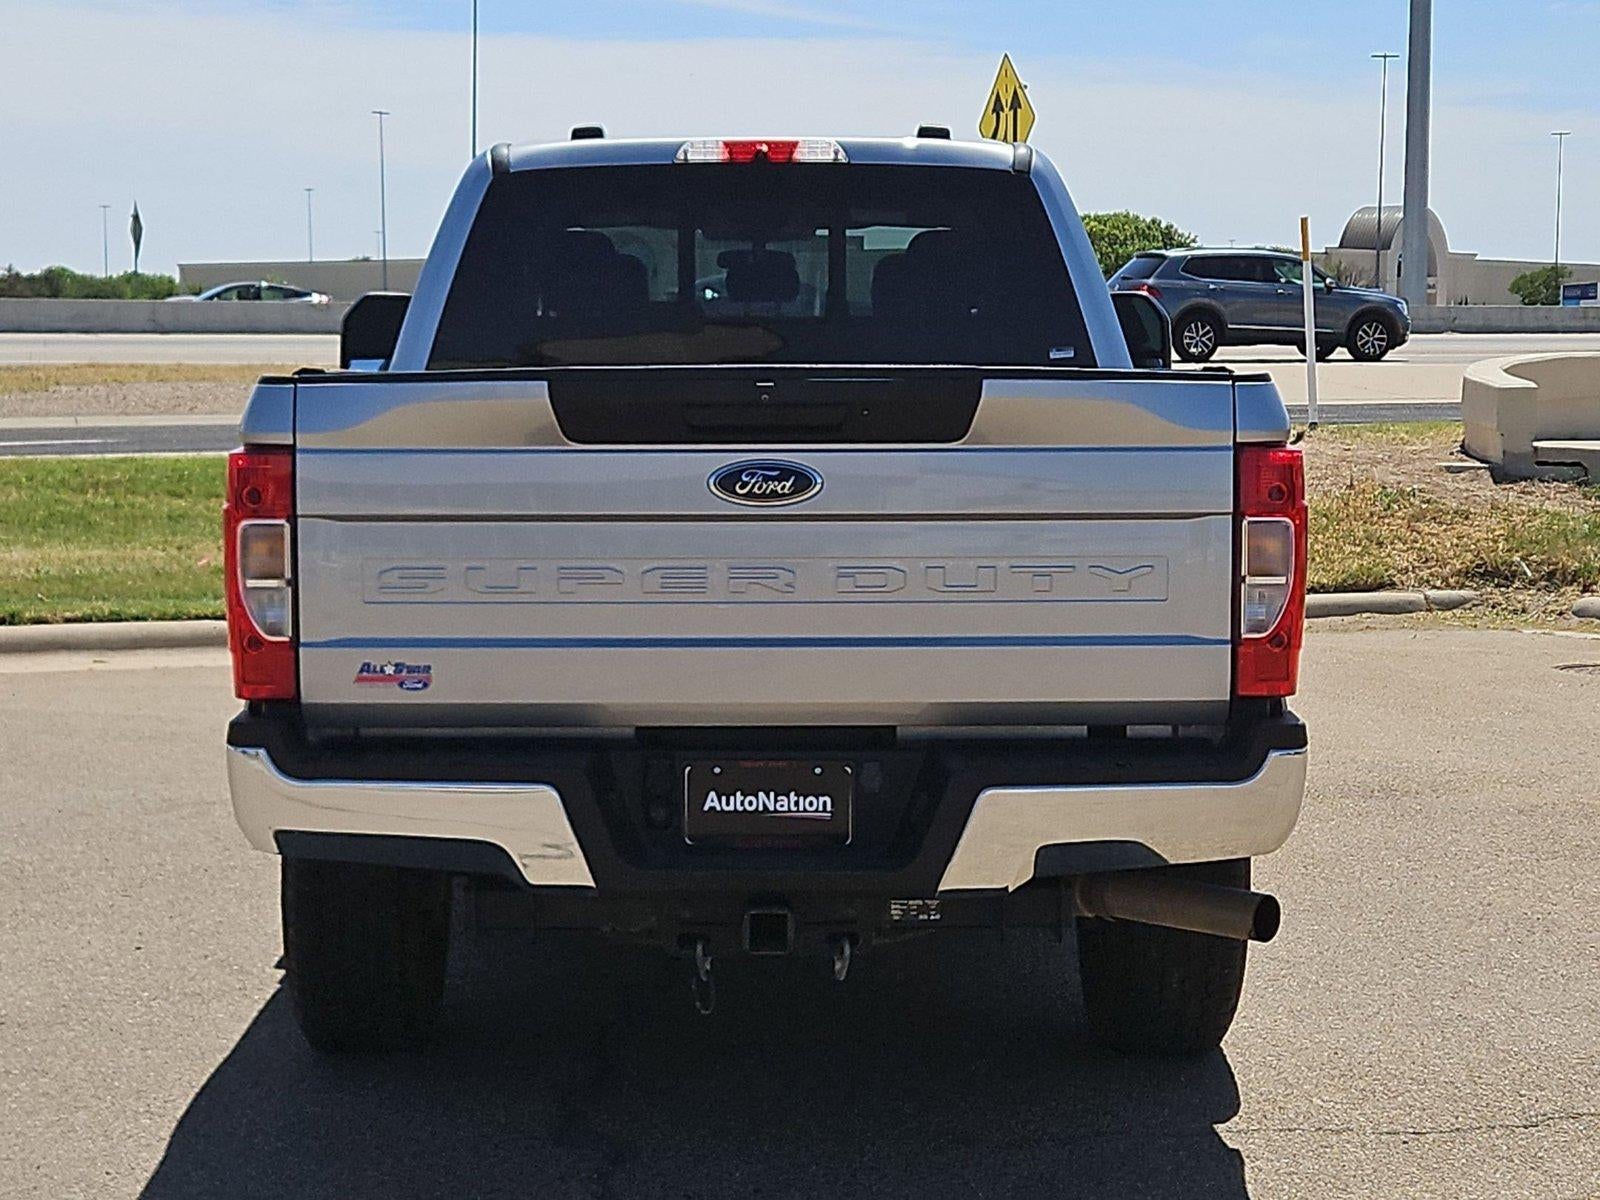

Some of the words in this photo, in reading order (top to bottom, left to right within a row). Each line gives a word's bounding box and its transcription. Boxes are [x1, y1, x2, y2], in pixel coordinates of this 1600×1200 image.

[735, 469, 795, 495] Ford
[377, 565, 795, 594] SUPER
[836, 565, 1154, 593] DUTY
[703, 790, 832, 811] AutoNation
